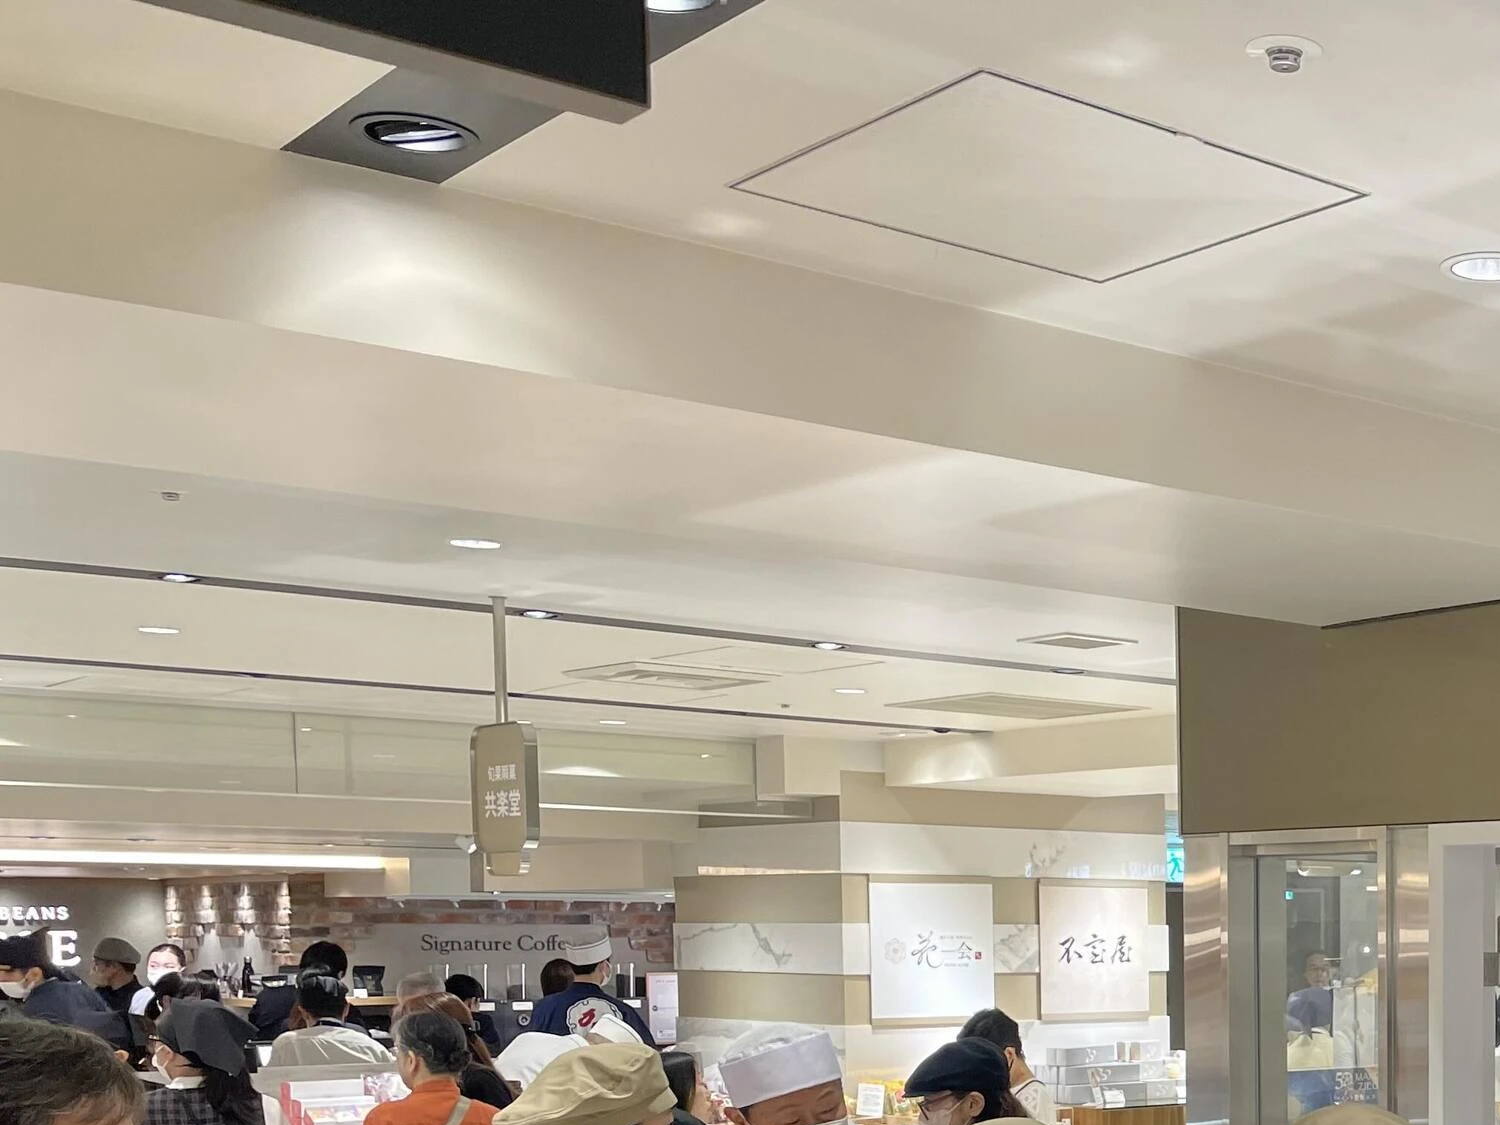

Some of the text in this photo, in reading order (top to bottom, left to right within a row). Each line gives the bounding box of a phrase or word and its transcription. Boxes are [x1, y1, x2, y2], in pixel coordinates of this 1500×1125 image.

[484, 788, 522, 818] 共楽堂
[0, 905, 70, 921] BEANS
[421, 934, 567, 955] Signature Coffe
